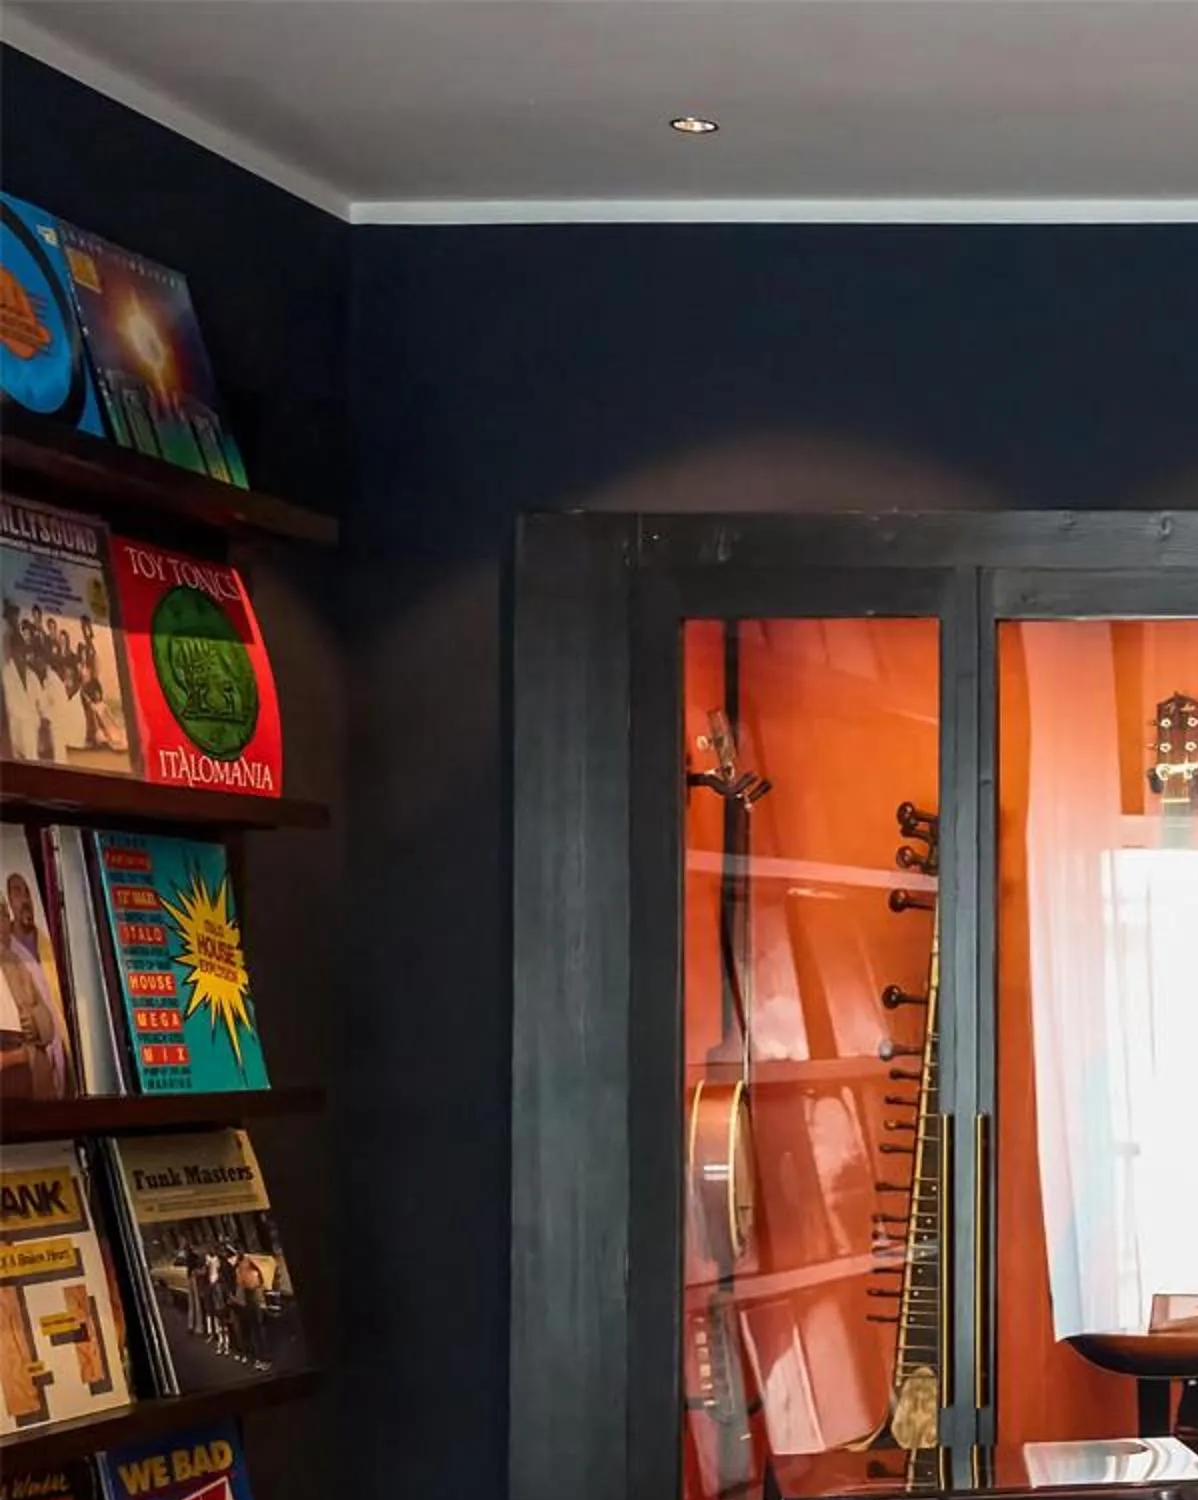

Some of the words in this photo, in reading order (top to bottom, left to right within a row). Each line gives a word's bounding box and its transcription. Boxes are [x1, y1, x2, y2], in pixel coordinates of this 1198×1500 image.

[124, 546, 166, 583] TOY
[169, 559, 242, 602] TONICS
[159, 745, 274, 790] ITALOMANIA
[196, 931, 237, 966] HOUSE
[129, 974, 174, 991] HOUSE
[137, 1011, 181, 1027] MEGA
[132, 1166, 183, 1190] Funk
[184, 1164, 256, 1185] Masters
[119, 1458, 172, 1497] WE
[173, 1440, 234, 1483] BAD
